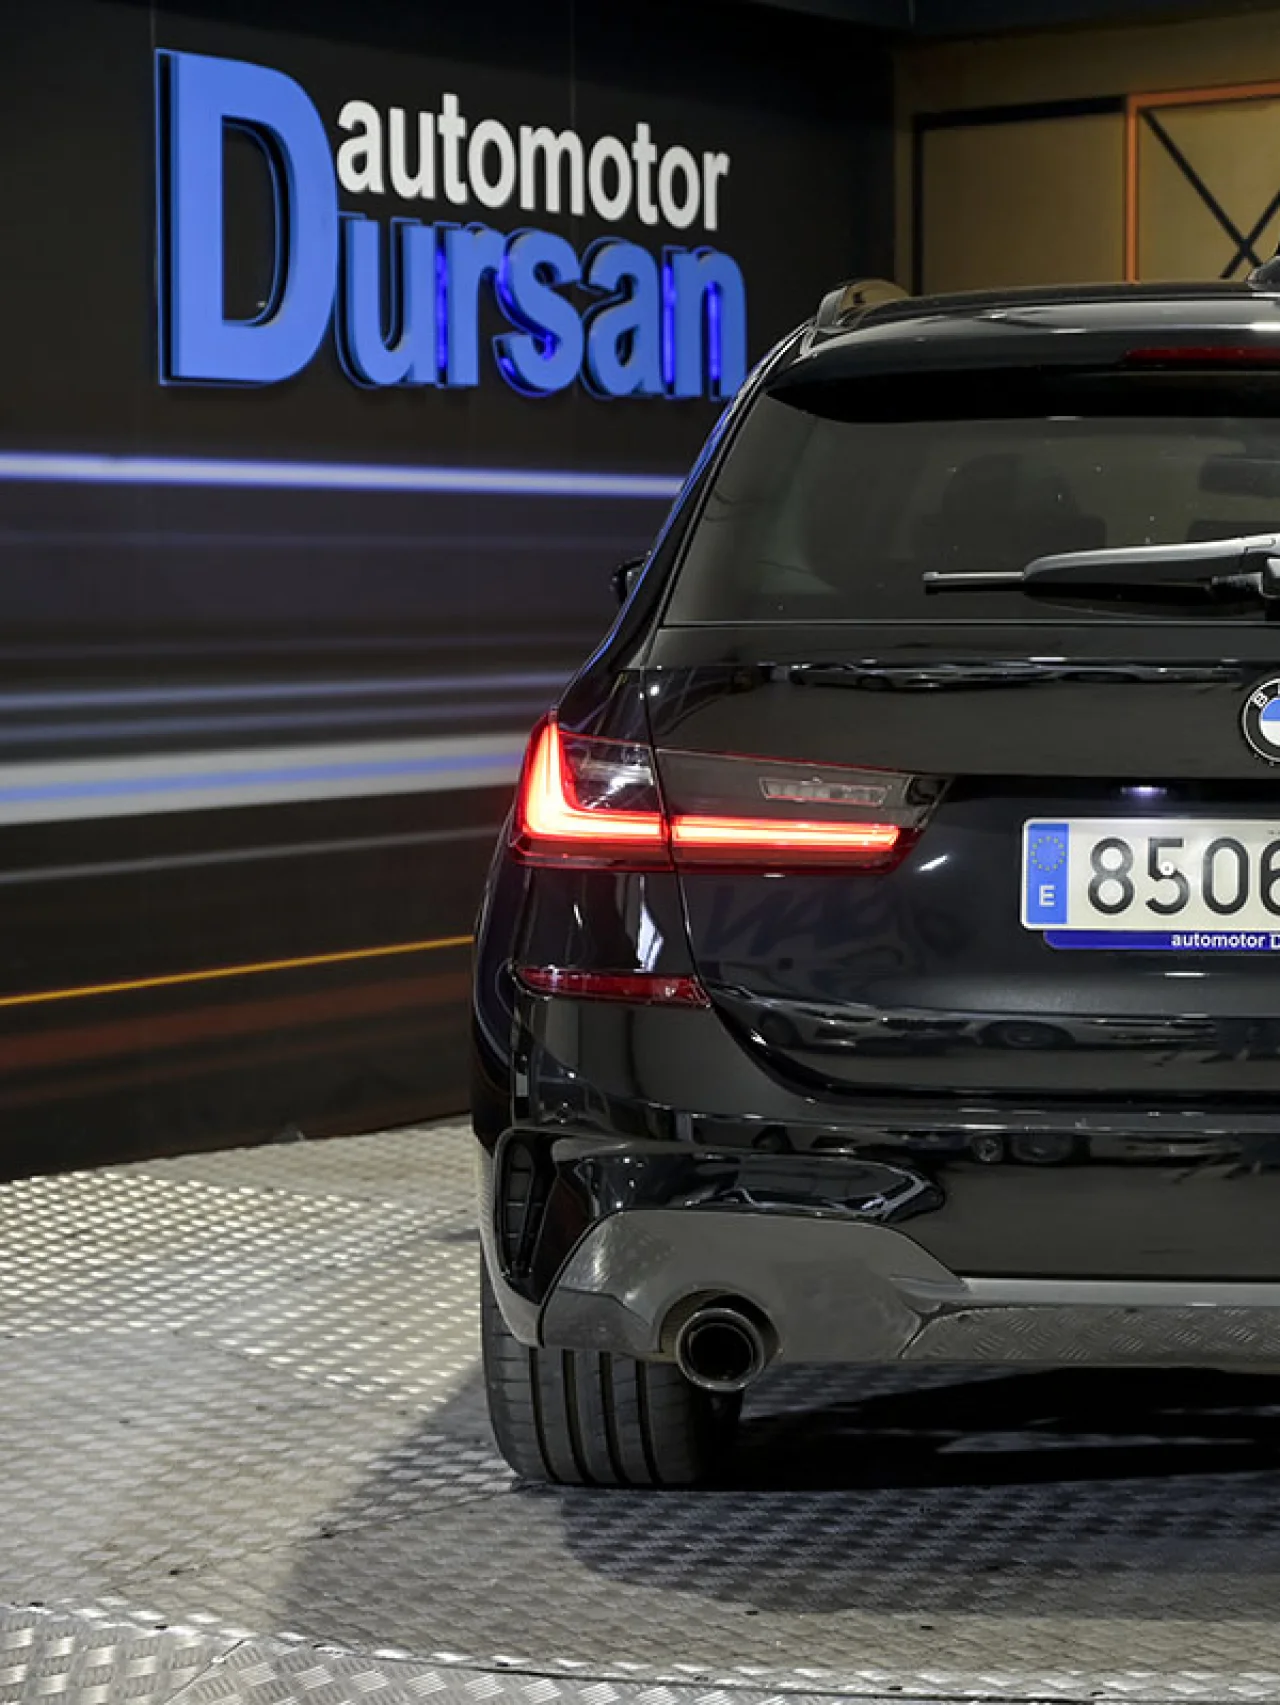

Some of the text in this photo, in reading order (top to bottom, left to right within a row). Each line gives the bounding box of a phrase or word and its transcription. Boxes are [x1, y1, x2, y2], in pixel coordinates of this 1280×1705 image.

[337, 93, 729, 231] automotor
[155, 48, 747, 398] Dursan
[1039, 885, 1055, 906] E
[1171, 932, 1266, 949] automotor
